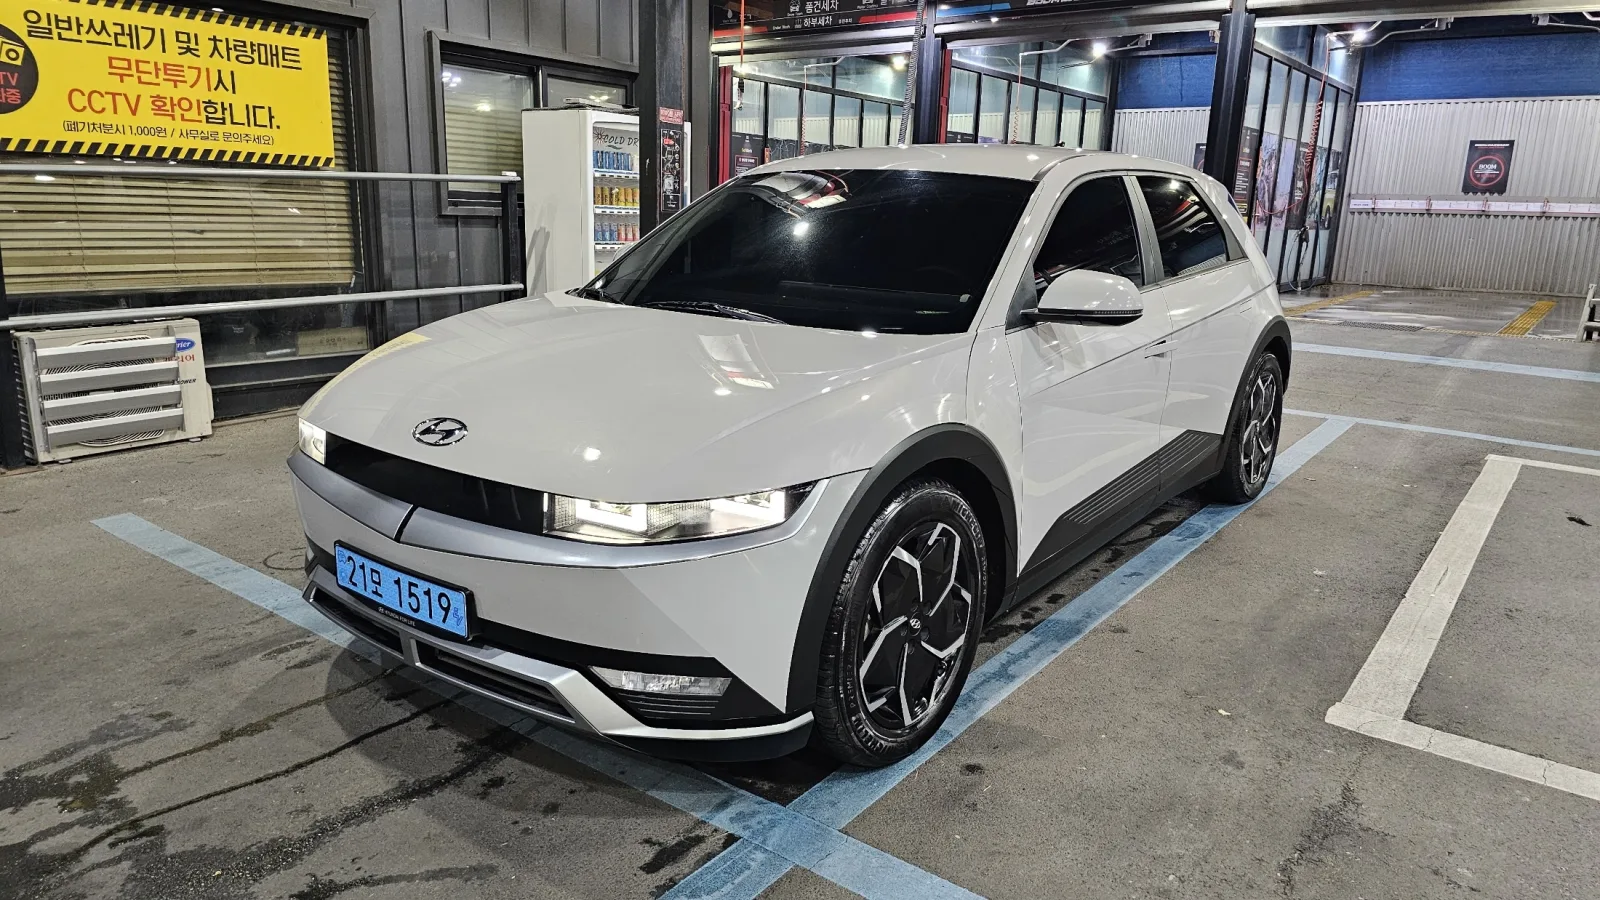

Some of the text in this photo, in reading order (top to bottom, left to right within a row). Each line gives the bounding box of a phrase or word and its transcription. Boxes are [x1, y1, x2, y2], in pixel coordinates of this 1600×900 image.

[23, 9, 302, 71] 일반쓰레기 및 차량매트
[803, 16, 833, 27] 하부세차
[108, 56, 236, 94] 무단투기시
[68, 88, 281, 130] CCTV 확인합니다.
[63, 120, 126, 136] (폐기처분시
[129, 125, 167, 138] 1,000원
[178, 129, 220, 142] 사무실로
[222, 131, 274, 146] 문의주세요)
[603, 134, 626, 145] COLD
[347, 555, 451, 624] 21모 1519
